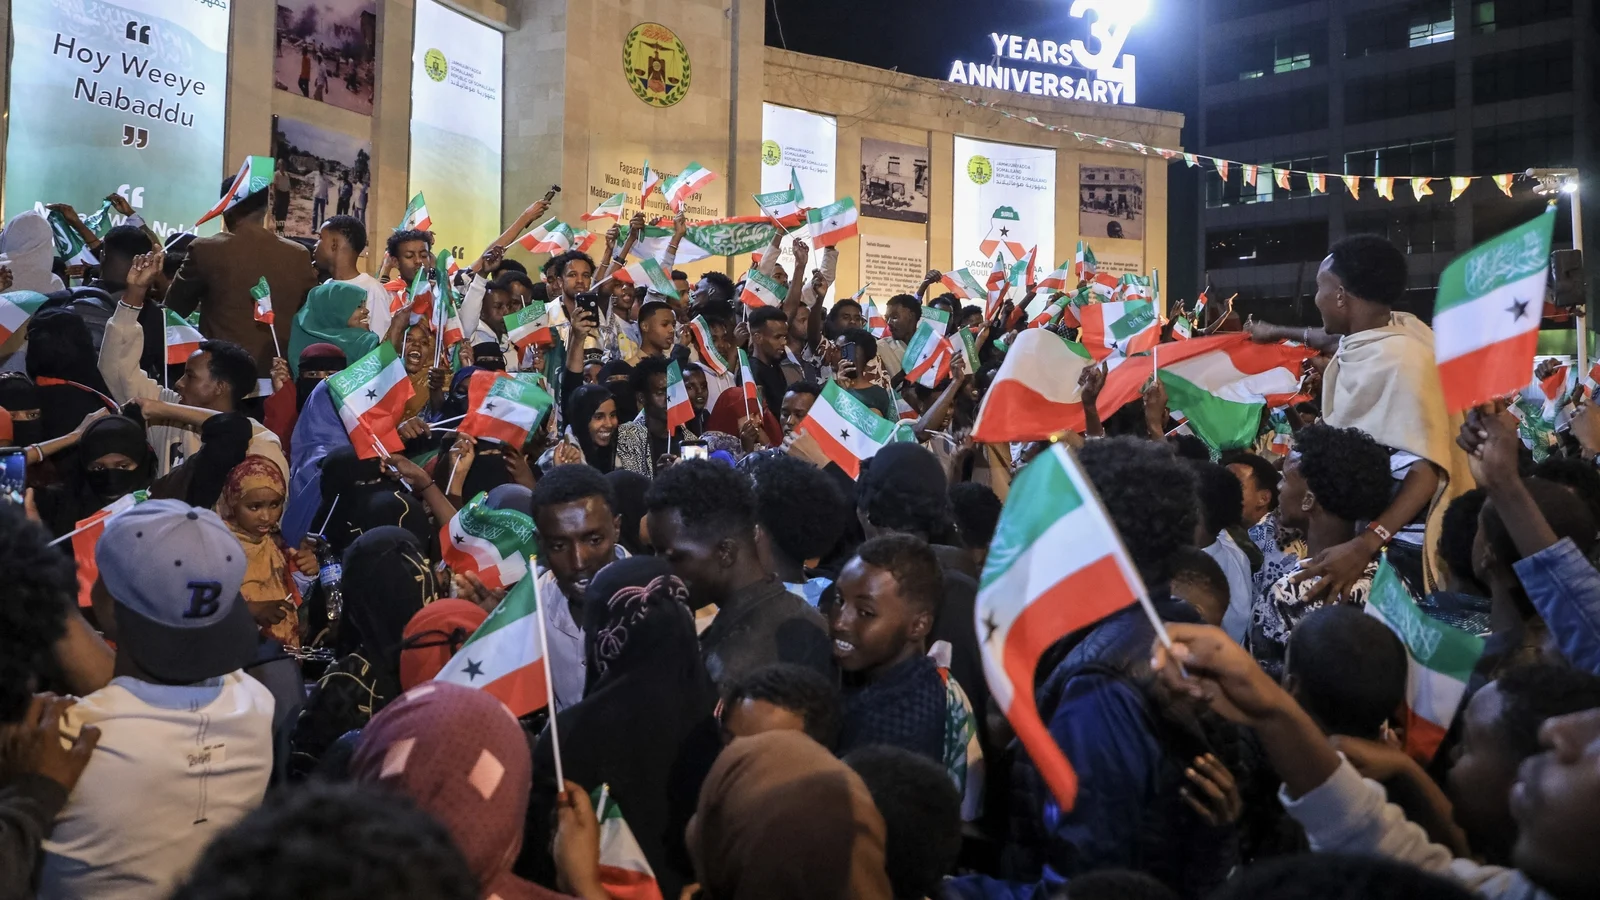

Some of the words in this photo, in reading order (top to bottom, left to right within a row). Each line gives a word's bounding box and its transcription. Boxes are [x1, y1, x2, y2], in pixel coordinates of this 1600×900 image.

[53, 33, 111, 73] Hoy
[121, 52, 206, 96] Weeye
[991, 32, 1073, 66] YEARS
[948, 59, 1123, 105] ANNIVERSARY
[74, 77, 194, 128] Nabaddu
[605, 173, 620, 186] Waxa
[621, 177, 631, 189] dib
[683, 203, 718, 217] Somaliland
[152, 220, 199, 238] Noll
[964, 260, 994, 269] GACMO
[182, 580, 223, 619] B
